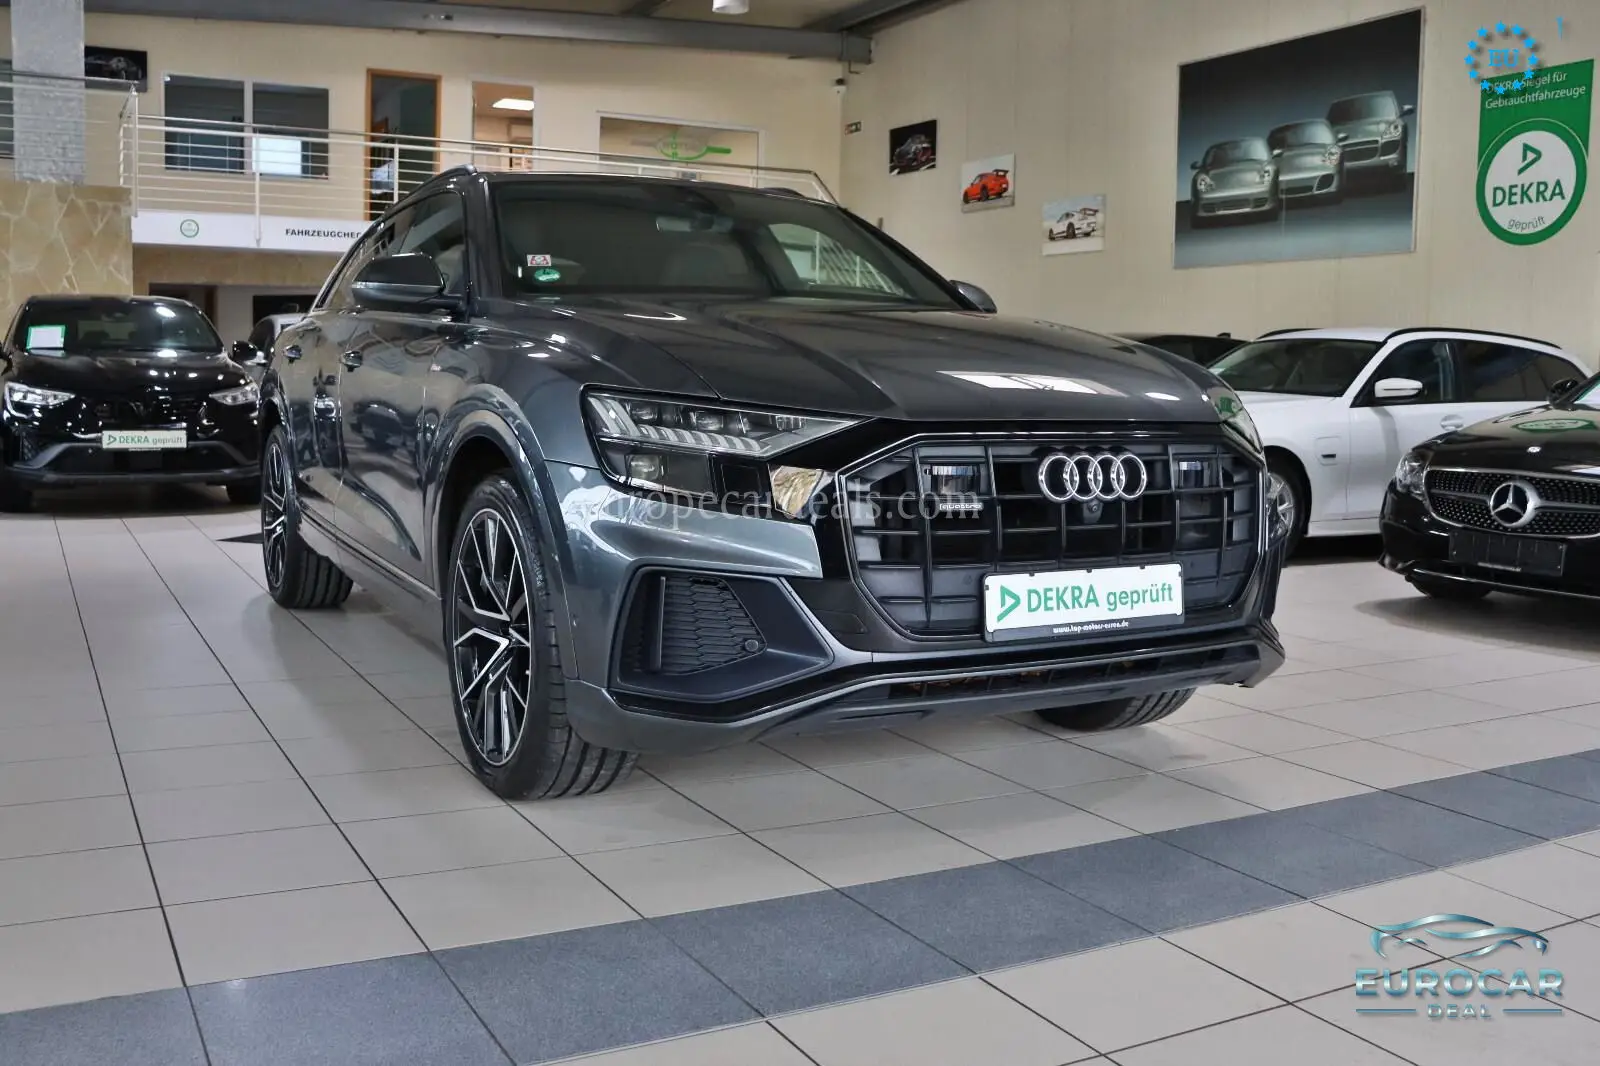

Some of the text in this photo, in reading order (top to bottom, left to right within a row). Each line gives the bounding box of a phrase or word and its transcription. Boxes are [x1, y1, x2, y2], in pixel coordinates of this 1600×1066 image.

[1482, 71, 1567, 93] DEKR Siegel für
[1485, 85, 1586, 109] Gebrauchtfahrzeuge
[1492, 179, 1565, 207] DEKRA
[1507, 216, 1546, 232] geprüft
[119, 435, 183, 446] DEKRA geprüft
[1027, 583, 1173, 613] DEKRA geprüft
